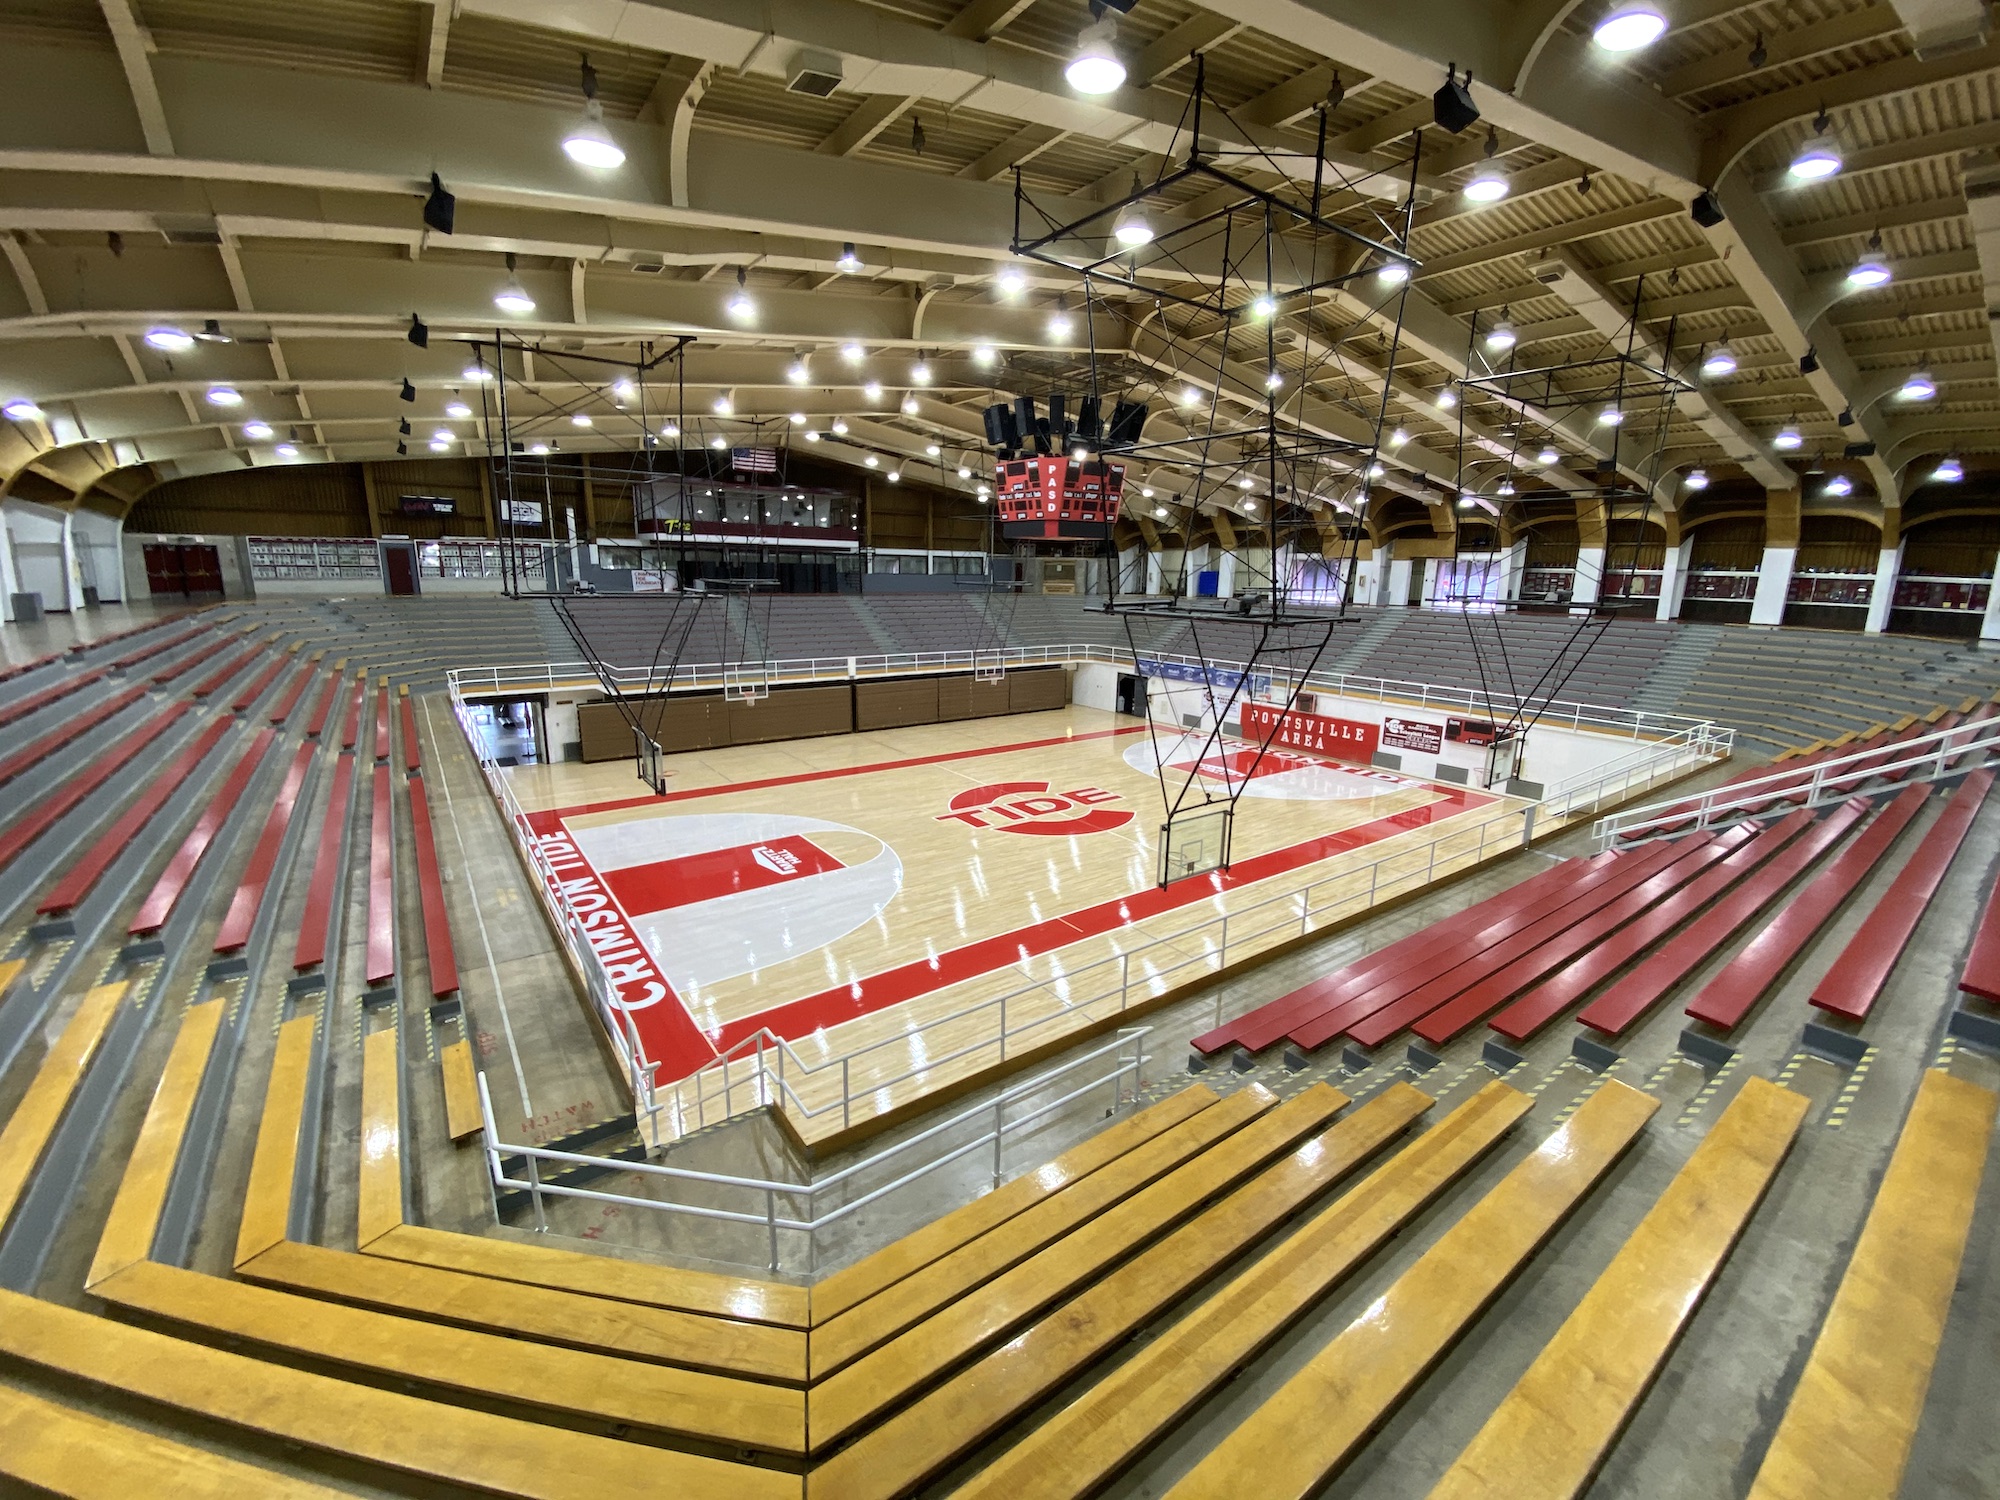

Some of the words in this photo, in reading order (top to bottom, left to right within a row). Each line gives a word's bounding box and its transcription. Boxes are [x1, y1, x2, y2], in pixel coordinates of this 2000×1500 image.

[1048, 464, 1057, 512] PASD
[1251, 709, 1365, 742] POTTSVILLE
[1280, 731, 1324, 750] AREA
[1337, 763, 1427, 789] TIDE
[932, 787, 1126, 829] TIDE
[777, 848, 803, 865] HALL
[551, 876, 667, 1012] CRIMSON
